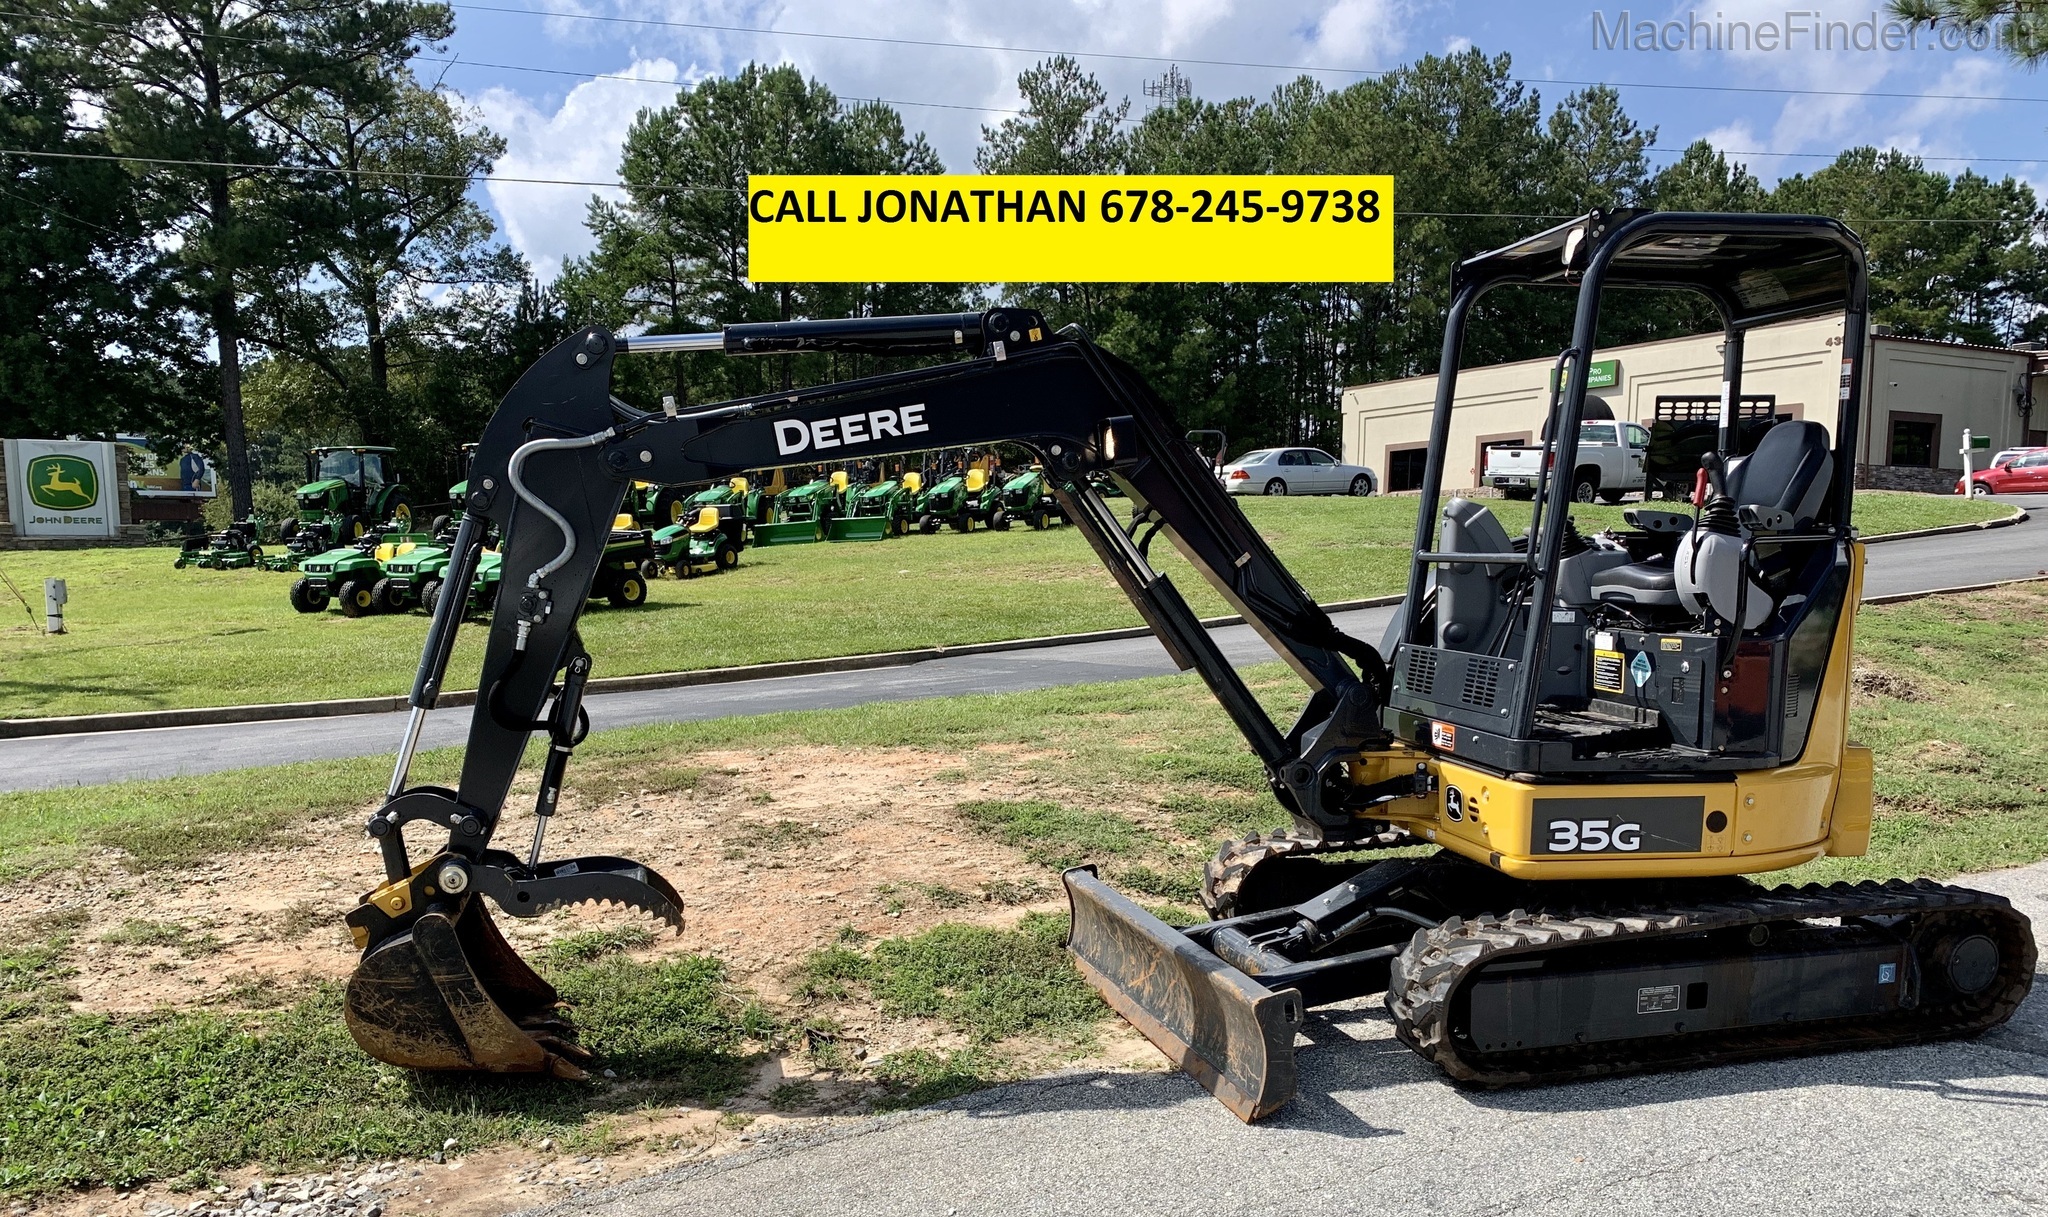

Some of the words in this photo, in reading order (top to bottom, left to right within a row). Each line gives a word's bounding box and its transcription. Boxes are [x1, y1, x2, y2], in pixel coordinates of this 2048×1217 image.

[773, 403, 929, 456] DEERE
[29, 515, 62, 524] JOHN
[63, 515, 103, 524] DEERE
[1549, 820, 1641, 852] 35G
